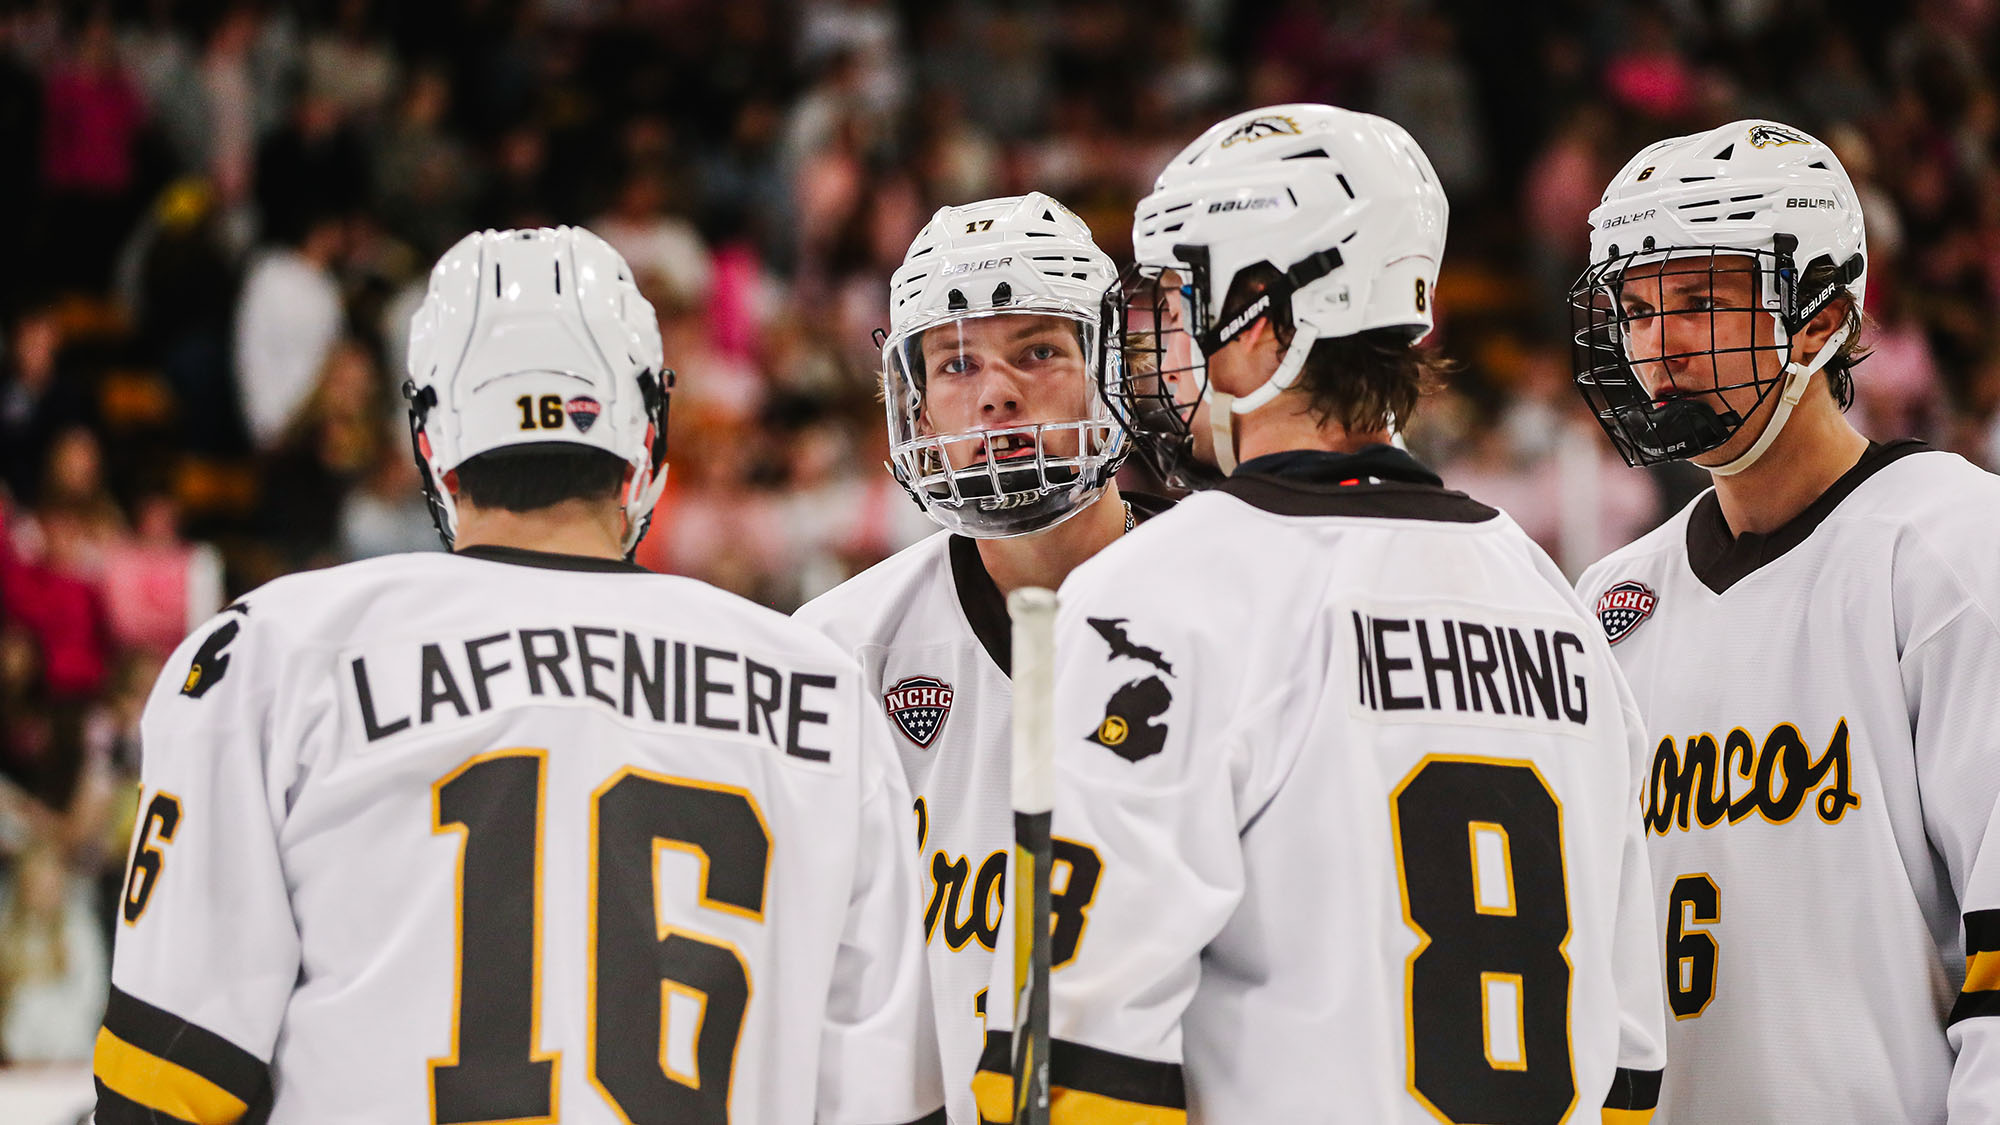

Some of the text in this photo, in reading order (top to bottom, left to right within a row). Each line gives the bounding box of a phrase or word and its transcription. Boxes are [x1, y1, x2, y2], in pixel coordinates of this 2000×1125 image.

[1637, 166, 1656, 182] 6
[1786, 198, 1835, 210] BAUER
[966, 219, 994, 234] 17
[1414, 277, 1426, 313] 8
[1800, 282, 1836, 320] BAUER
[1219, 294, 1271, 343] BAUER
[515, 394, 564, 431] 16
[1598, 592, 1653, 612] NCHC
[1351, 610, 1588, 726] NEHRING
[352, 626, 837, 763] LAFRENIERE
[886, 689, 952, 711] NCHC
[1640, 716, 1861, 840] oncos
[122, 782, 184, 927] 6
[427, 747, 775, 1125] 16
[1388, 752, 1580, 1125] 8
[1665, 872, 1721, 1022] 6
